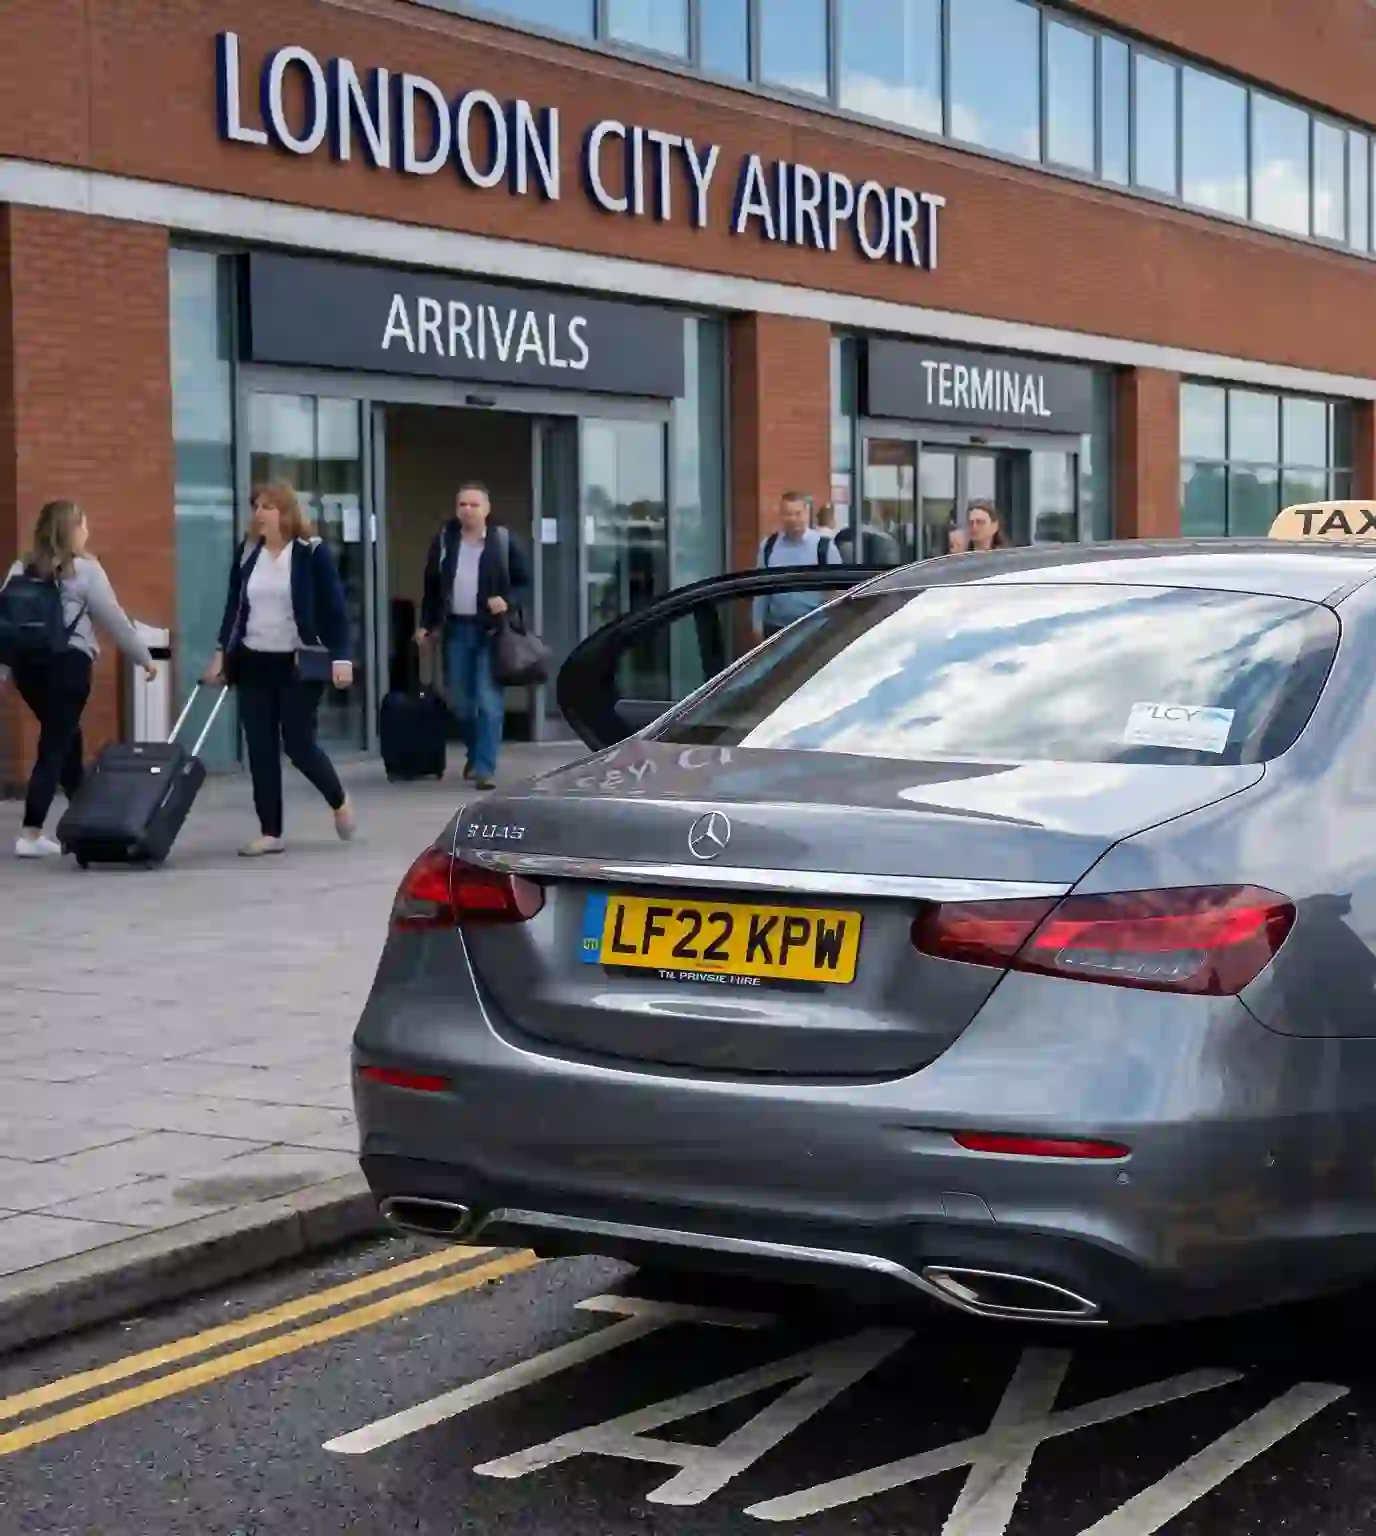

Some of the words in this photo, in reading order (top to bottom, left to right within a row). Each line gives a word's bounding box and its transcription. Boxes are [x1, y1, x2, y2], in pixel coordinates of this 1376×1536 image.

[217, 31, 561, 201] LONDON
[583, 120, 721, 229] CITY
[731, 153, 946, 269] AIRPORT
[381, 293, 590, 370] ARRIVALS
[920, 360, 1051, 416] TERMINAL
[611, 904, 734, 961] LF22
[745, 914, 847, 970] KPW
[322, 1294, 1350, 1536] TAXI
